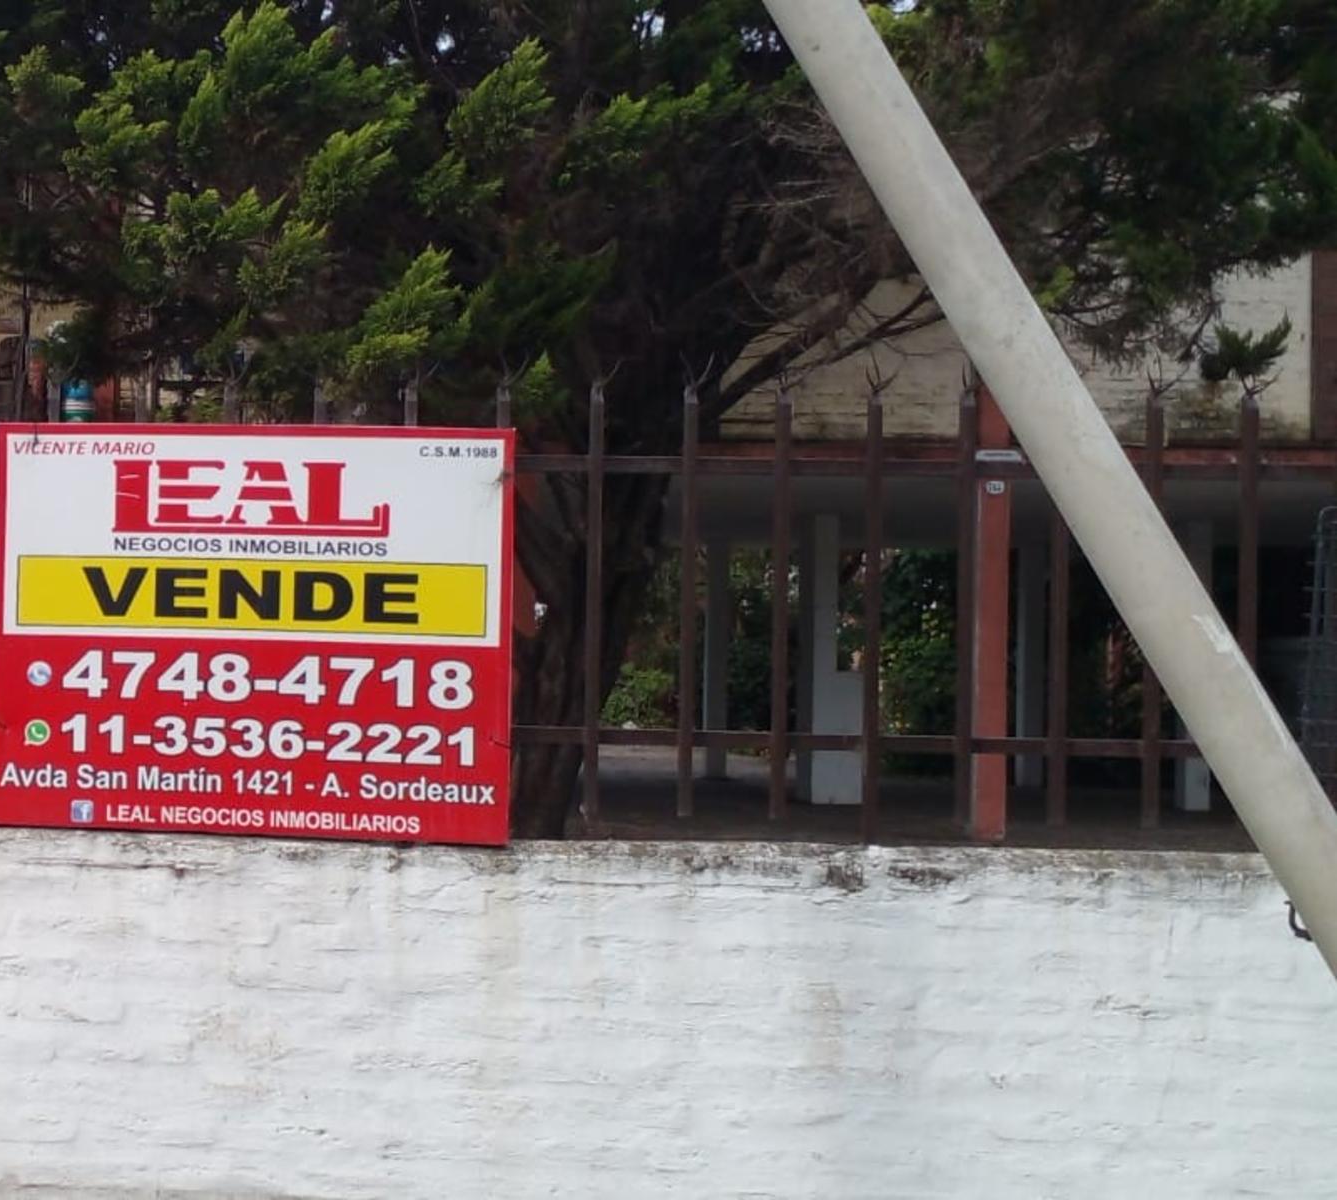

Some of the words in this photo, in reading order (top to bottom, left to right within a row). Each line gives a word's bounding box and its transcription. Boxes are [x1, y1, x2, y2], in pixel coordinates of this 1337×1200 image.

[13, 441, 88, 455] VICENTE
[92, 441, 155, 456] MARIO
[112, 460, 389, 537] LEAL
[114, 537, 221, 553] NEGOCIOS
[229, 539, 387, 557] INMOBILIARIOS
[83, 566, 419, 624] VENDE
[62, 650, 473, 709] 4748-4718
[60, 714, 475, 766] 11-3536-2221
[1, 763, 68, 788] Avda
[77, 765, 127, 790] San
[137, 766, 223, 793] Martín
[233, 770, 294, 795] 1421
[321, 774, 349, 798] A.
[360, 775, 495, 804] Sordeaux
[106, 805, 155, 822] LEAL
[160, 807, 263, 826] NEGOCIOS
[270, 811, 420, 833] INMOBILIARIOS
